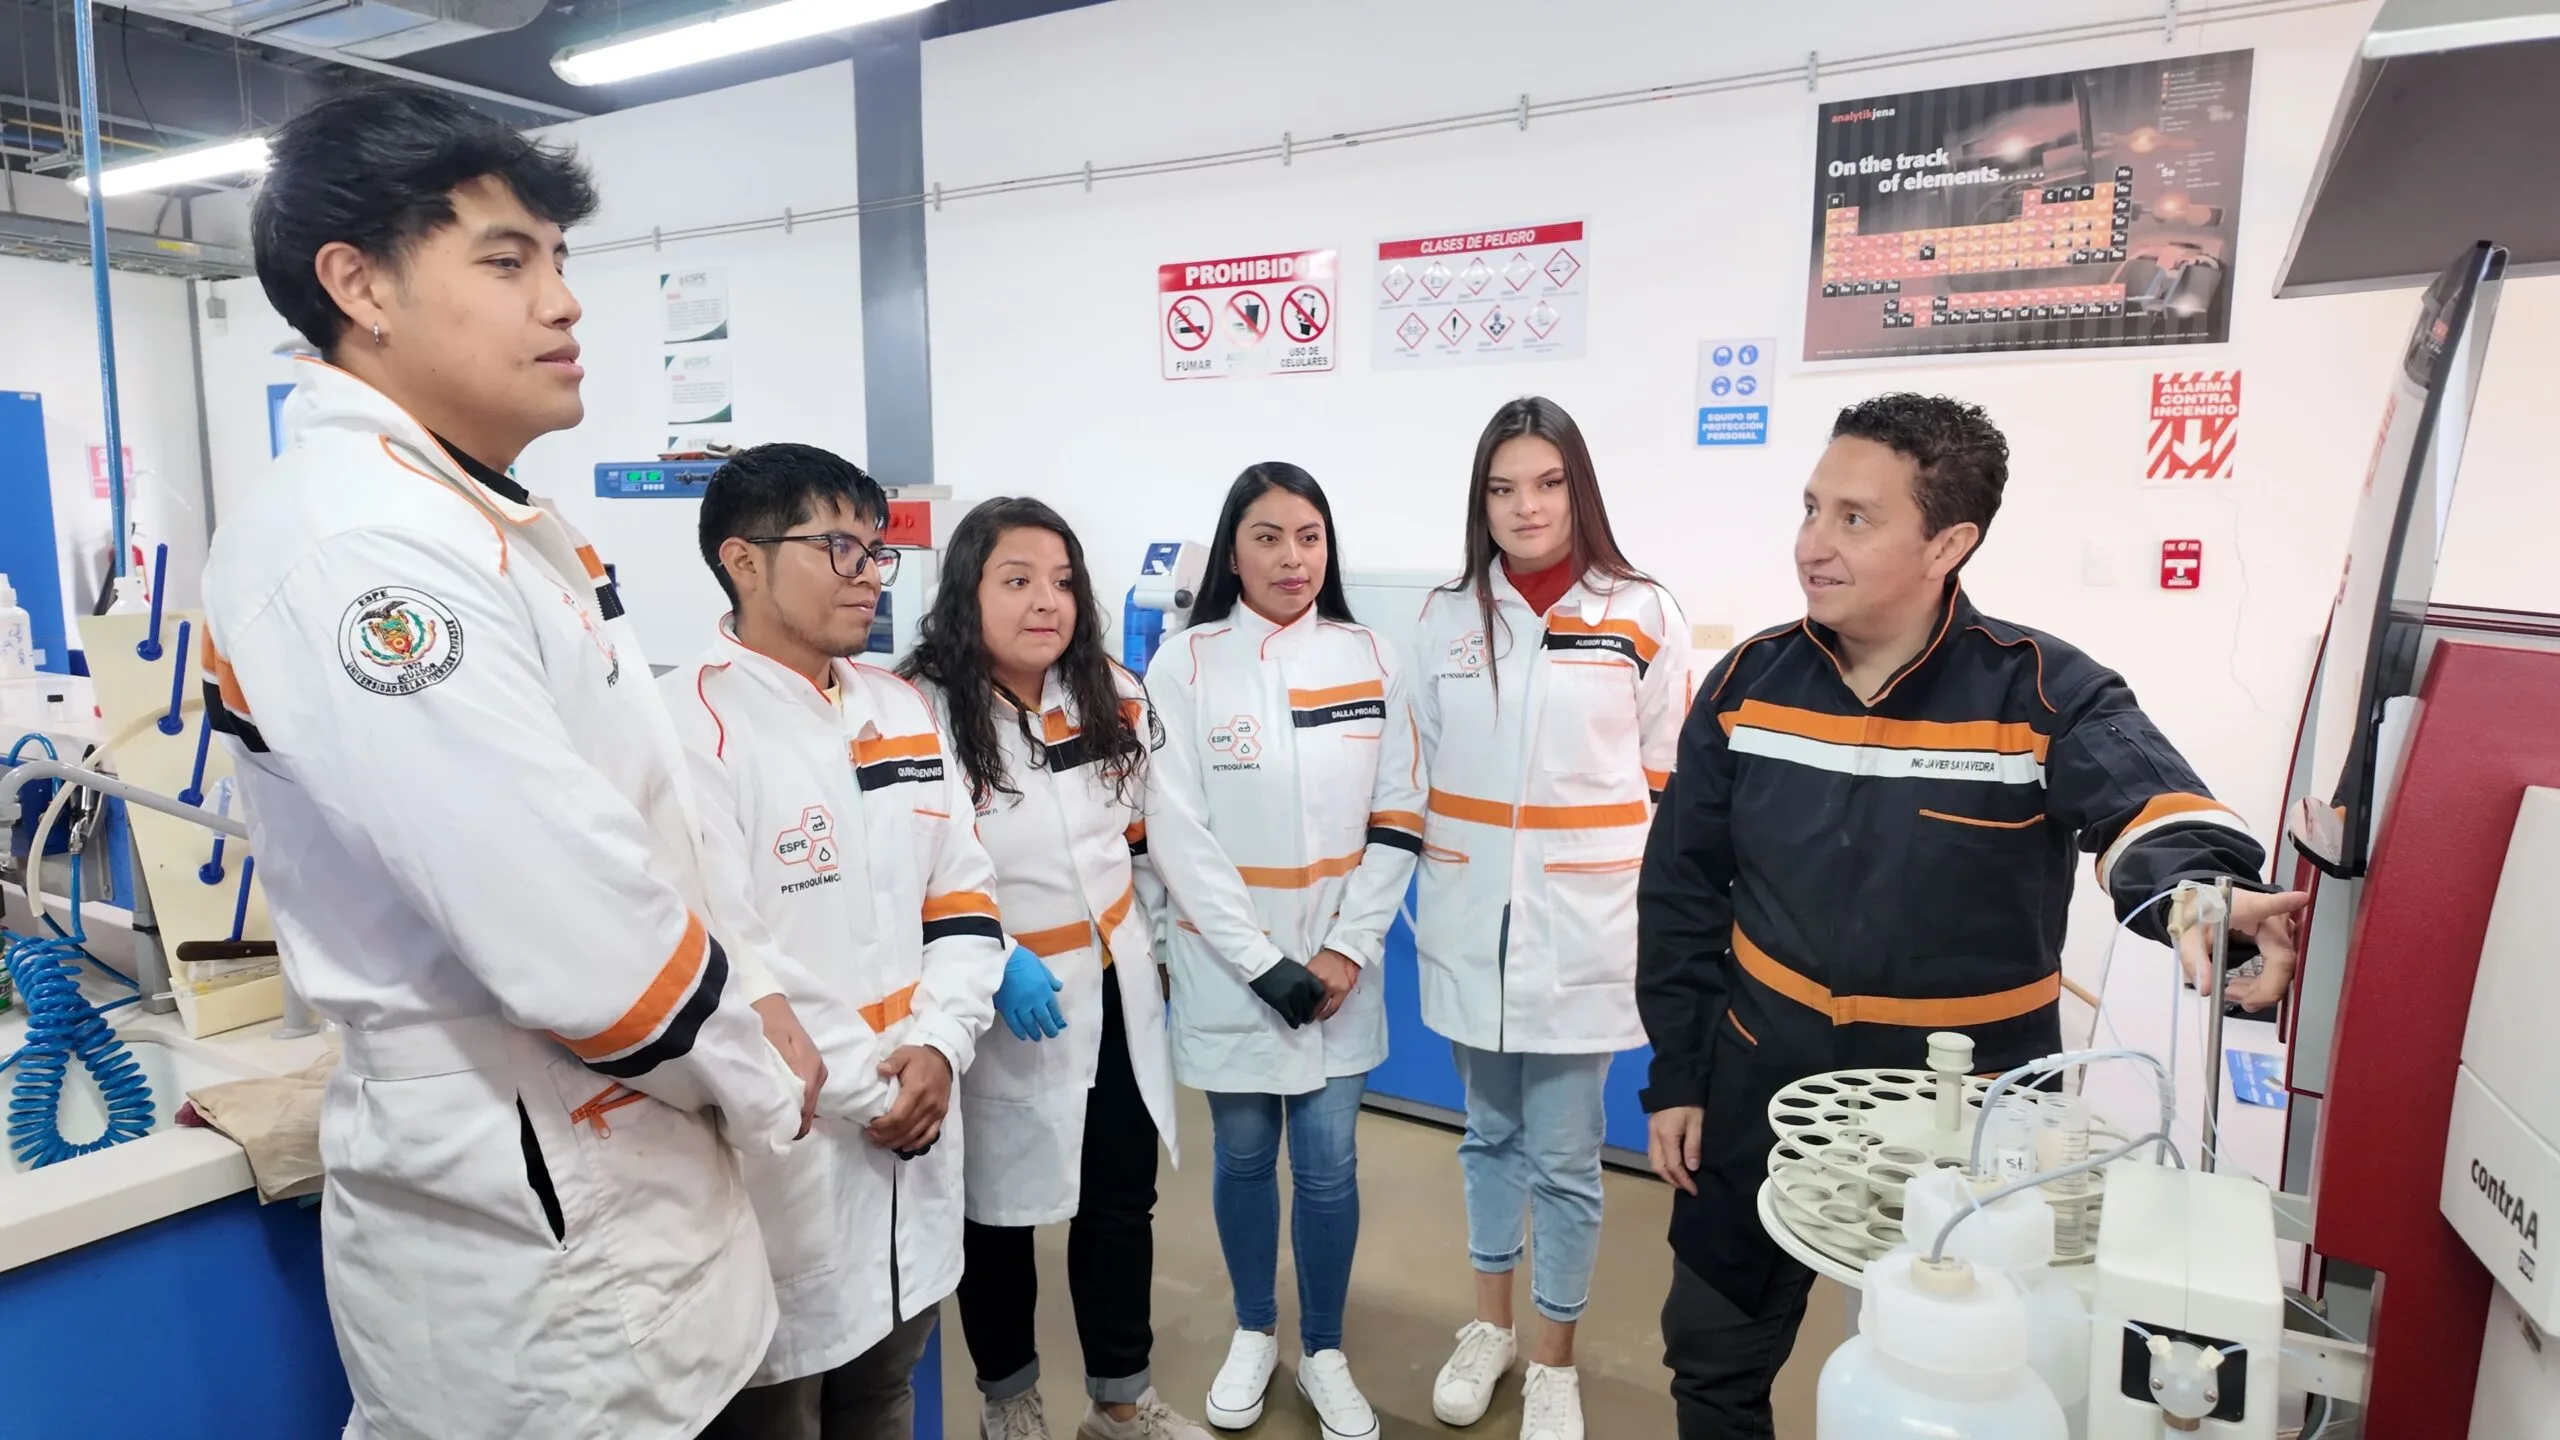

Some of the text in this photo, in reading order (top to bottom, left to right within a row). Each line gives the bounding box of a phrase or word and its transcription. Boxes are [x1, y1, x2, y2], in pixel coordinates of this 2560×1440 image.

[1831, 107, 1896, 124] analytikjena
[1828, 147, 1950, 178] On the track
[1878, 176, 1901, 193] of
[1420, 229, 1536, 253] CLASES DE PELIGRO
[1288, 346, 1320, 357] USO DE
[1176, 359, 1212, 372] FUMAR
[1280, 356, 1328, 368] CELULARES
[2160, 381, 2233, 393] ALARMA
[2159, 393, 2232, 405] CONTRA
[2153, 404, 2238, 417] INCENDIO
[358, 589, 388, 607] ESPE
[345, 661, 397, 692] UNIVERSIDAD
[399, 684, 410, 692] DE
[779, 839, 808, 854] ESPE
[2471, 1157, 2539, 1250] contrAA
